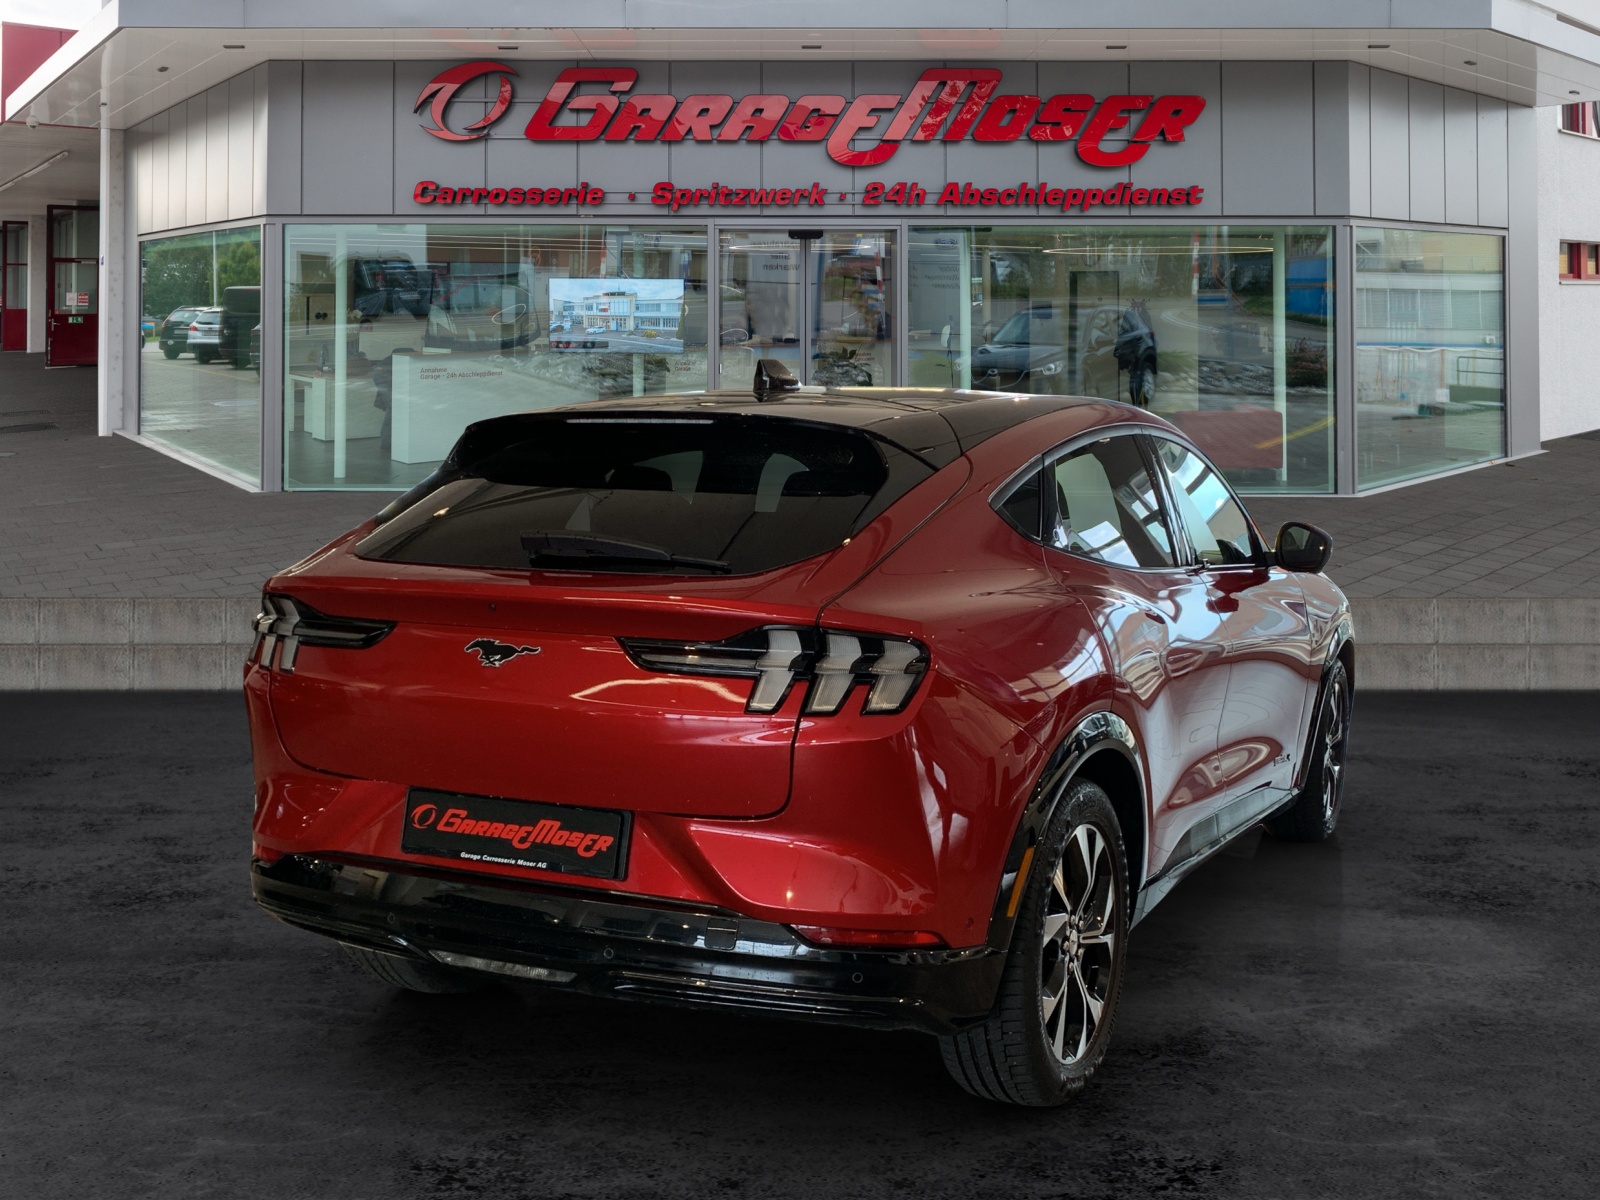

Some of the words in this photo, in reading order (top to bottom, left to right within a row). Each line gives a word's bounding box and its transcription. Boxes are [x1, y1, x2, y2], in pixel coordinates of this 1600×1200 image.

[413, 181, 604, 205] Carrosserie
[651, 182, 826, 210] Spritzwerk
[862, 182, 926, 205] 24h
[938, 182, 1204, 210] Abschleppdienst
[460, 852, 481, 860] Garage
[482, 855, 515, 864] Carrosserie
[517, 859, 536, 867] Moser
